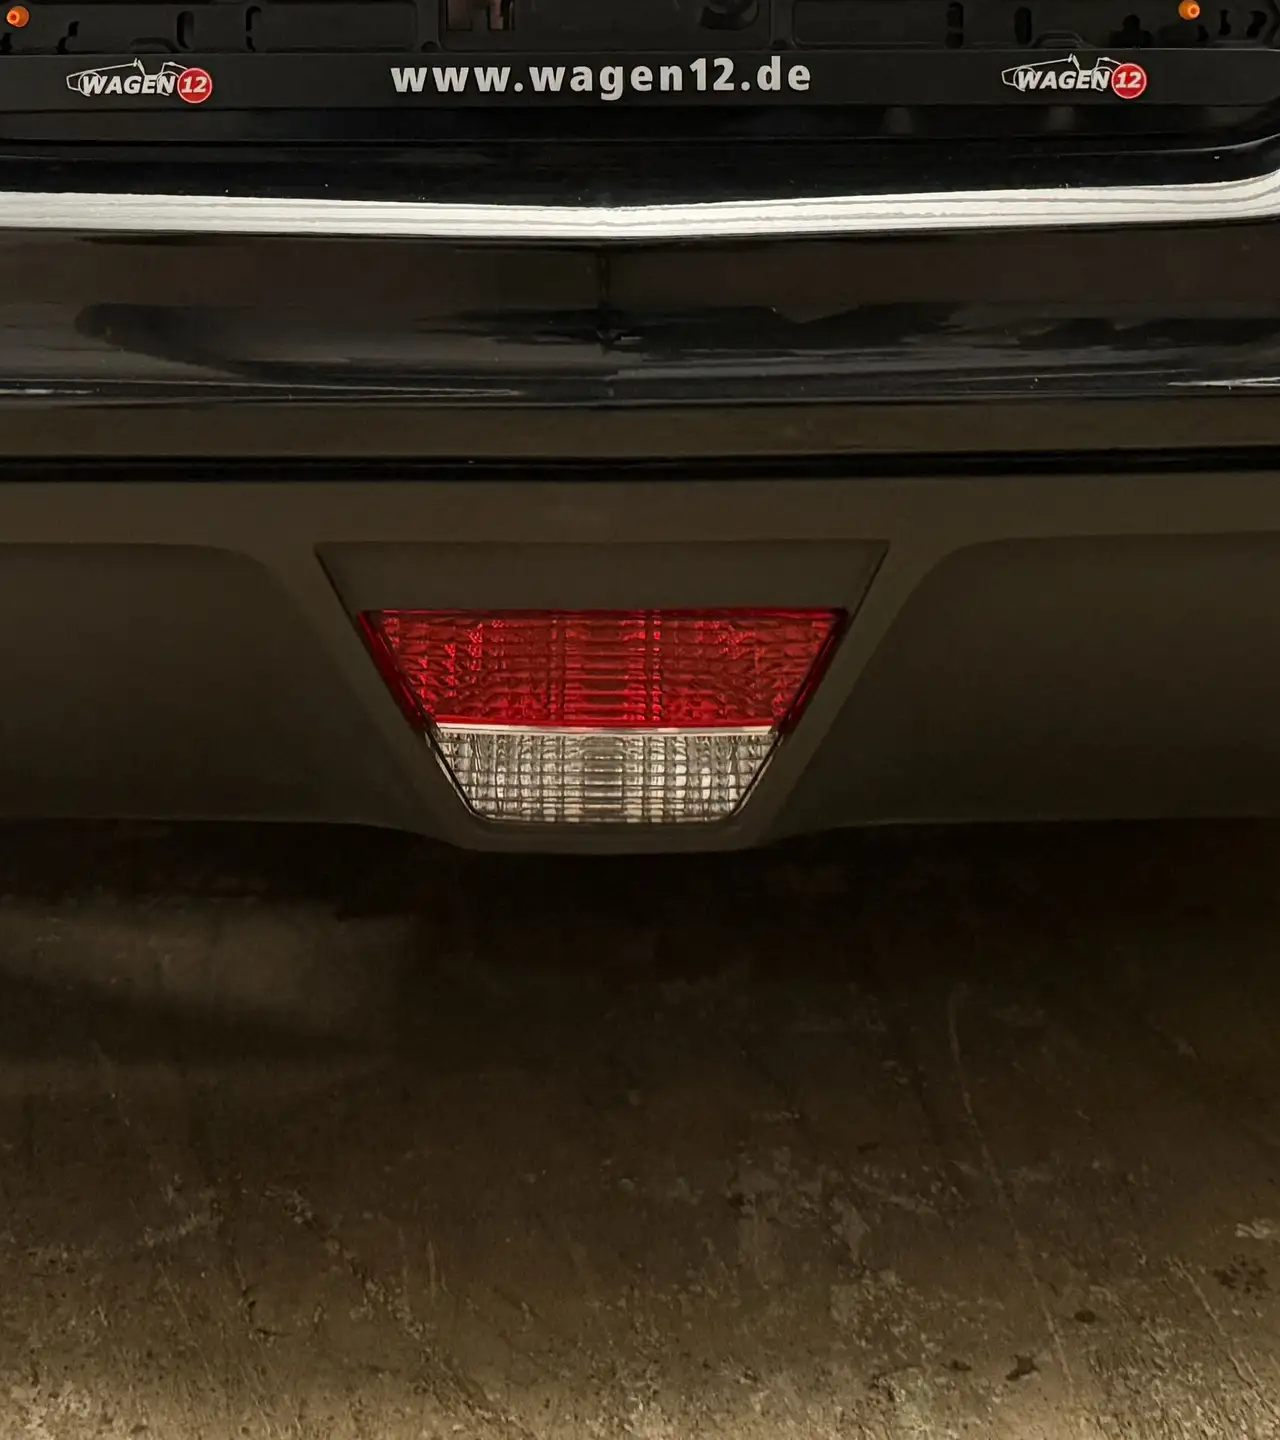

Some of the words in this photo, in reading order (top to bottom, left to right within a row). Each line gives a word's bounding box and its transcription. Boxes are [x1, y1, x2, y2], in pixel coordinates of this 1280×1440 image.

[82, 74, 176, 96] WAGEN
[180, 77, 209, 95] 12
[390, 56, 812, 100] www.wagen12.de
[1016, 71, 1110, 92] WAGEN
[1115, 72, 1143, 90] 12
